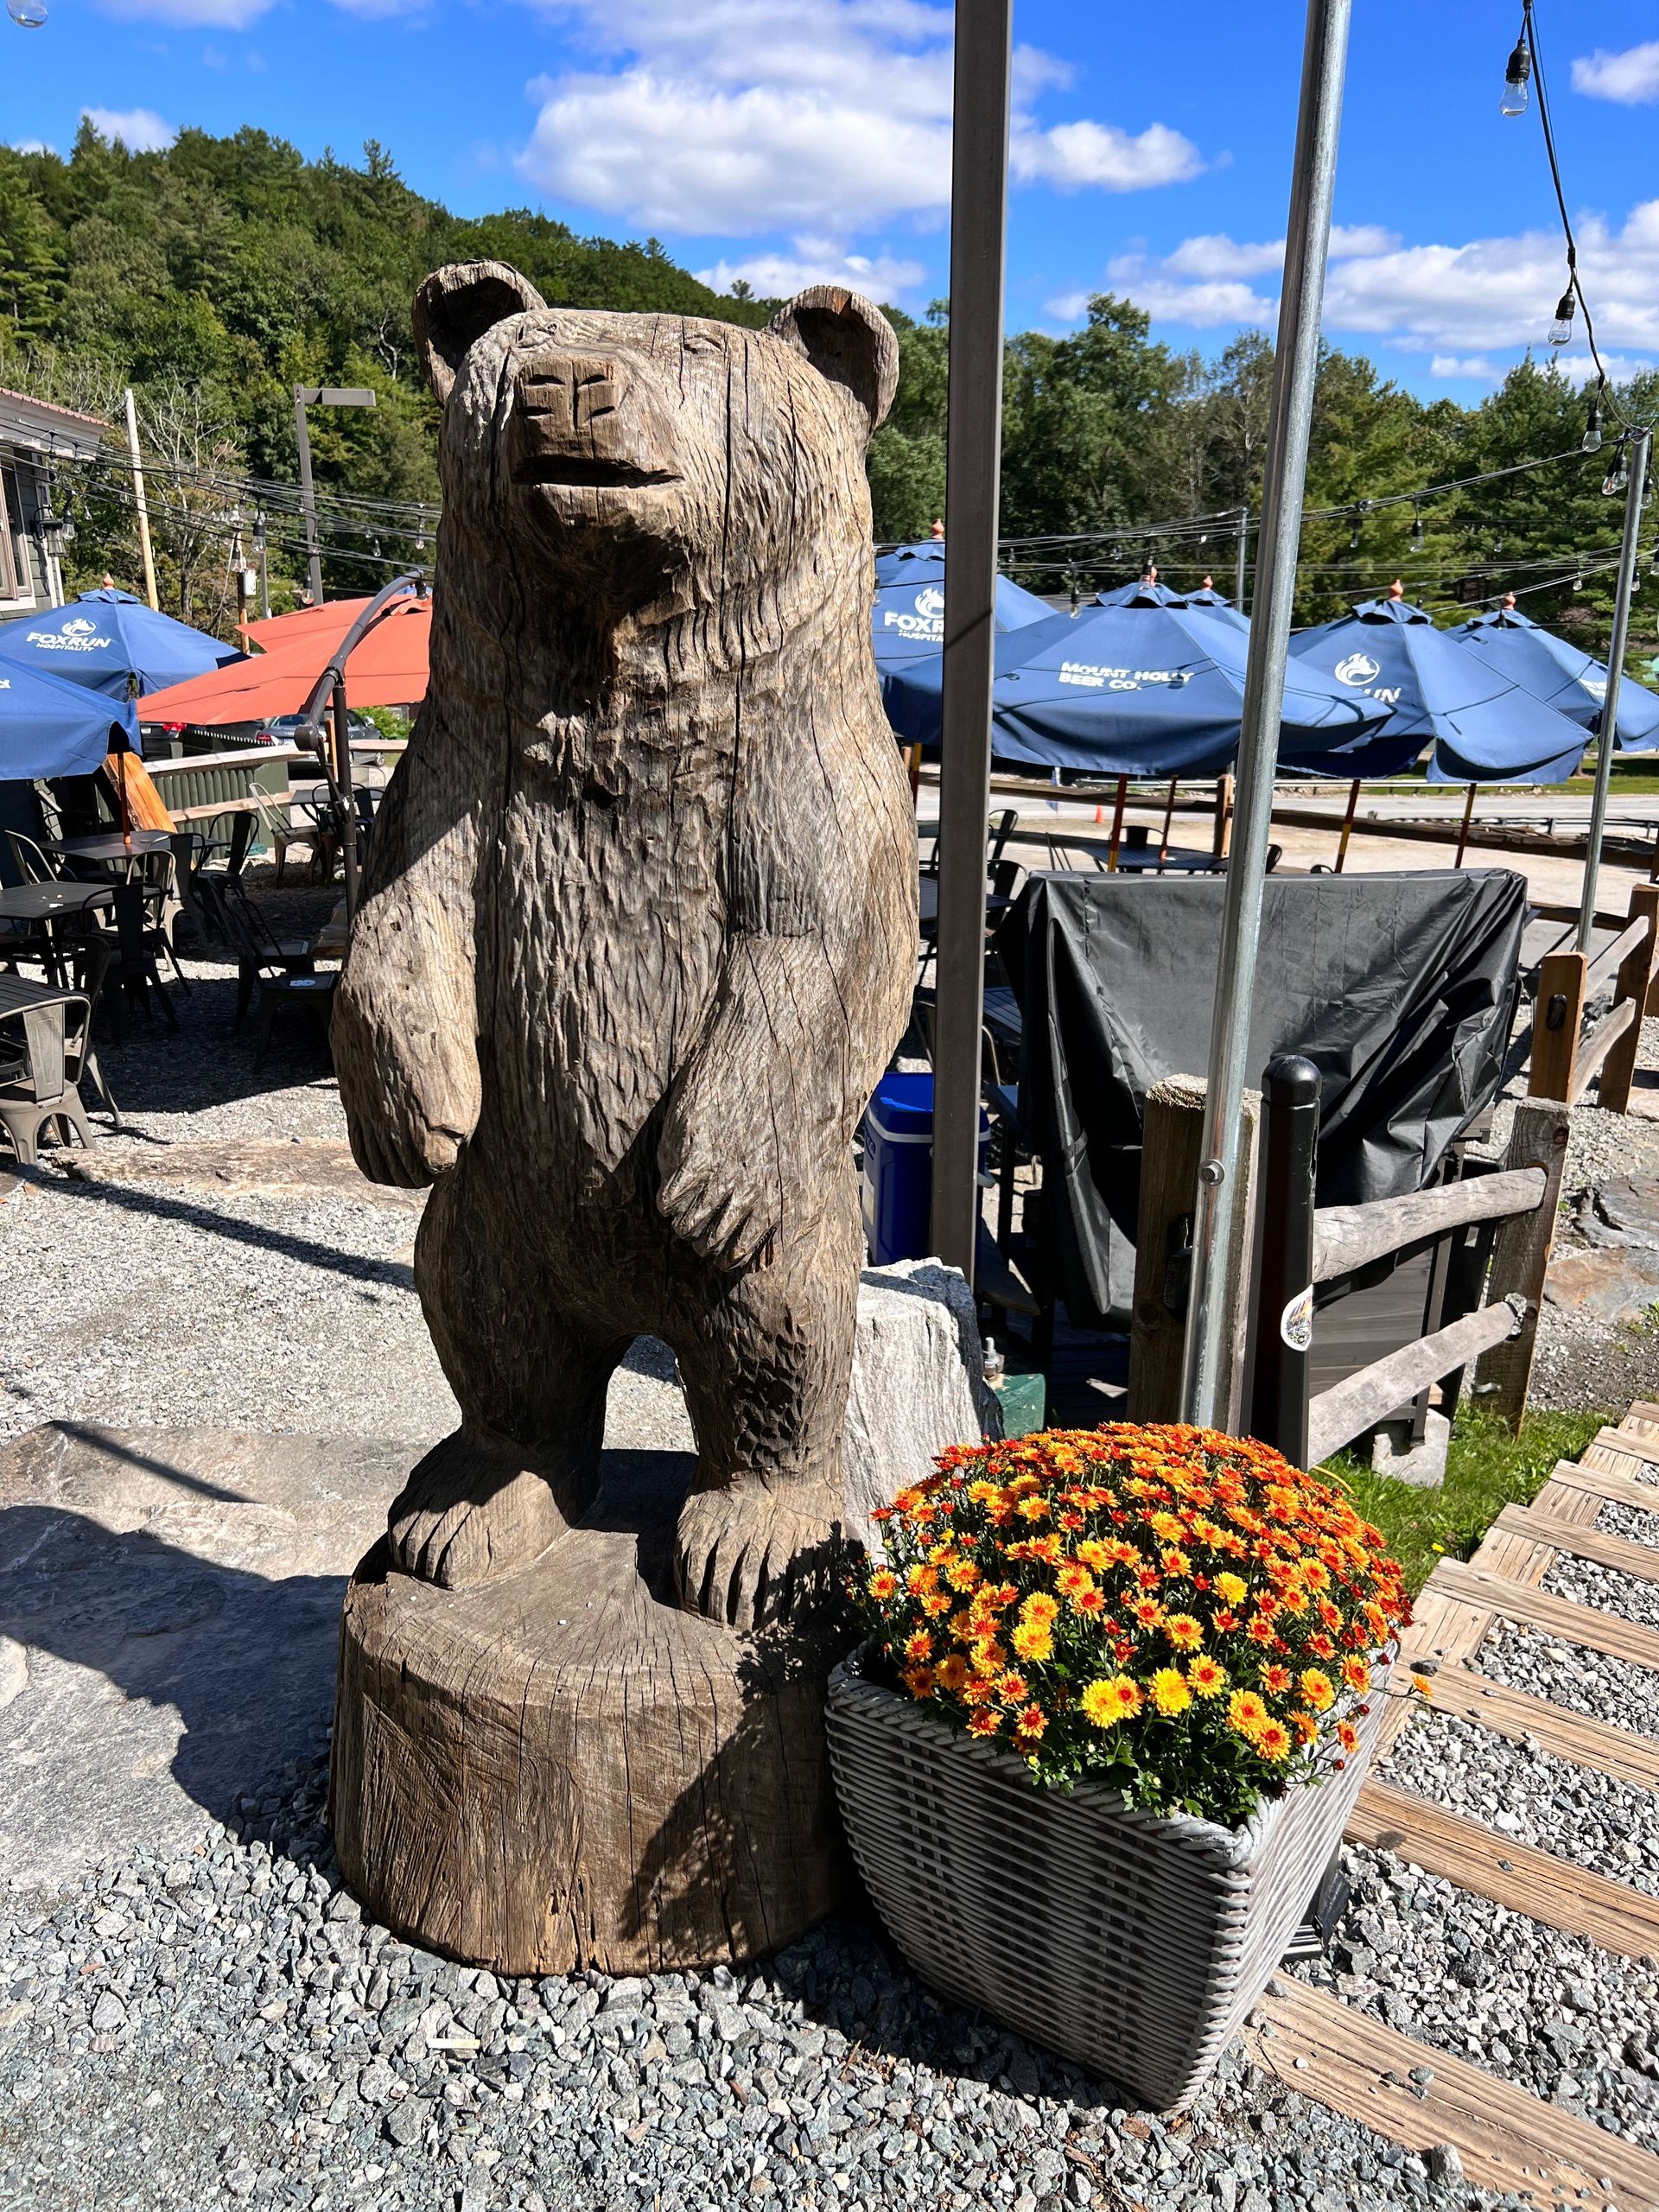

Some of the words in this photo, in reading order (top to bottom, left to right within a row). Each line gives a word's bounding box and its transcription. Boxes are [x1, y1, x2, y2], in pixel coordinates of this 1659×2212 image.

[884, 612, 944, 632] FOXR
[26, 632, 111, 647] FOXRUN
[35, 643, 94, 652] HOSPITALITY
[1061, 662, 1130, 678] MOUNT
[1058, 672, 1104, 687] BEER
[1109, 679, 1142, 690] CO.
